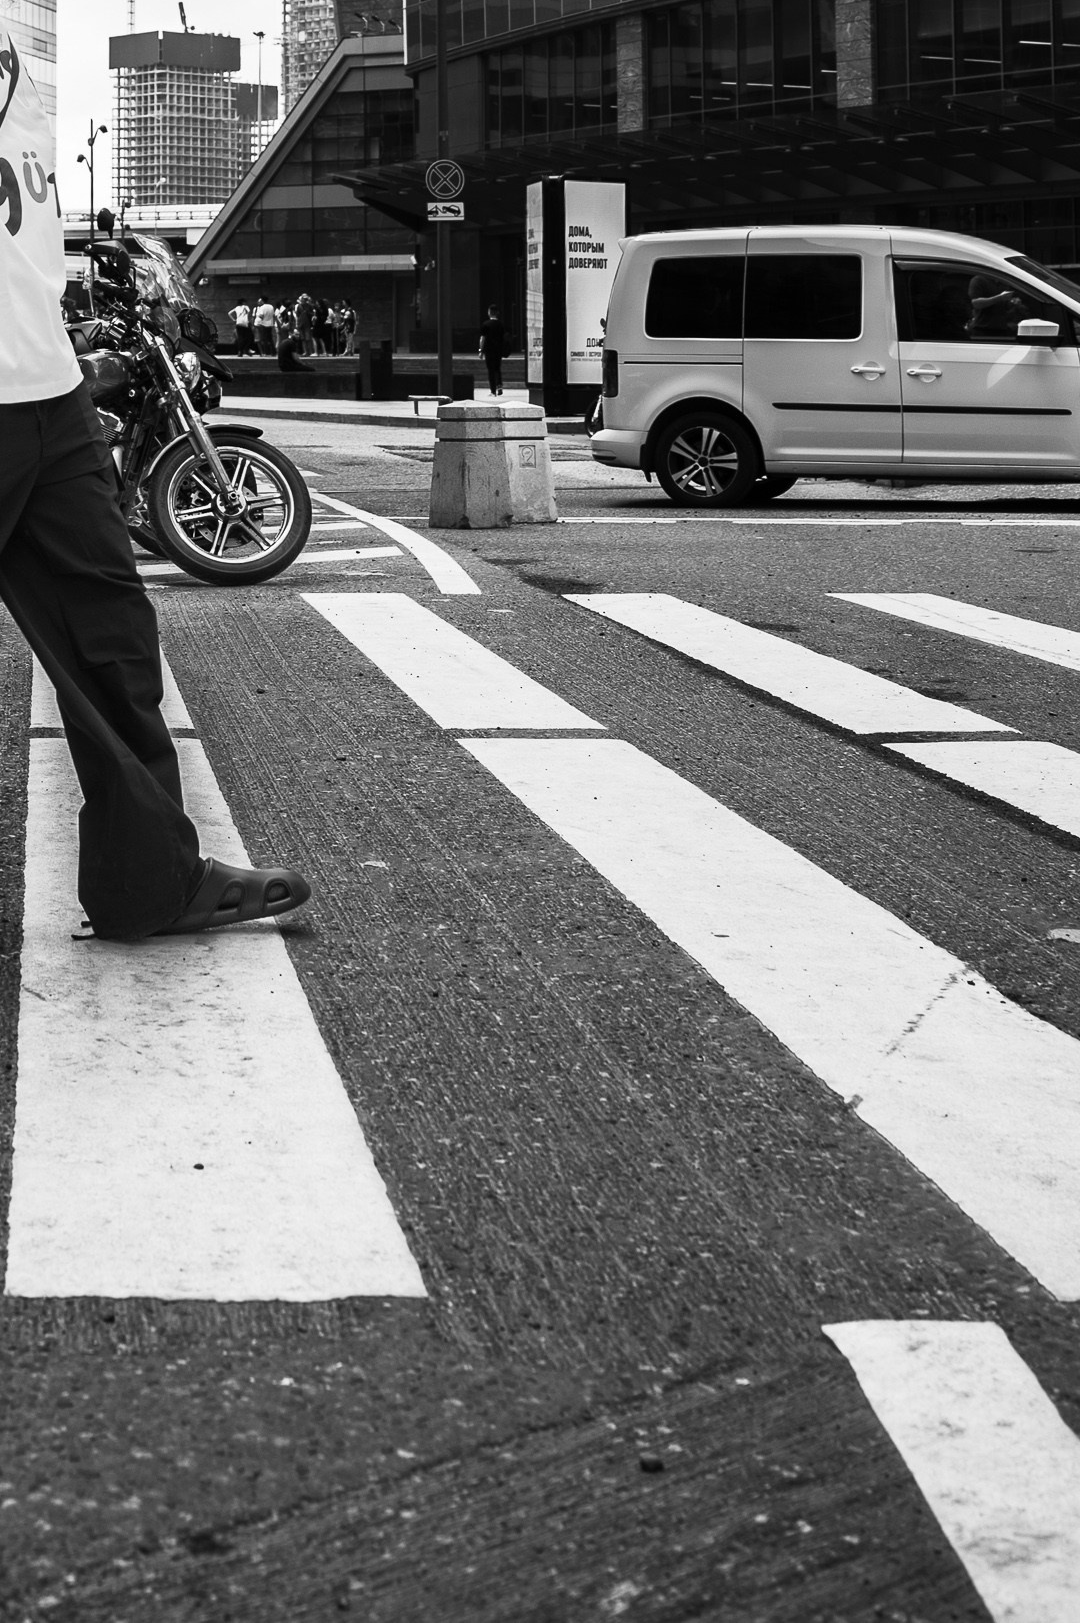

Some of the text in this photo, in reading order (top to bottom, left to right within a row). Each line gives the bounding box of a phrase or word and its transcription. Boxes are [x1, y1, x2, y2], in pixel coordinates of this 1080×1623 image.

[568, 226, 592, 238] ДОМА,
[569, 242, 604, 253] КОТОРЫМ
[568, 258, 607, 269] ДОВЕРЯЮТ
